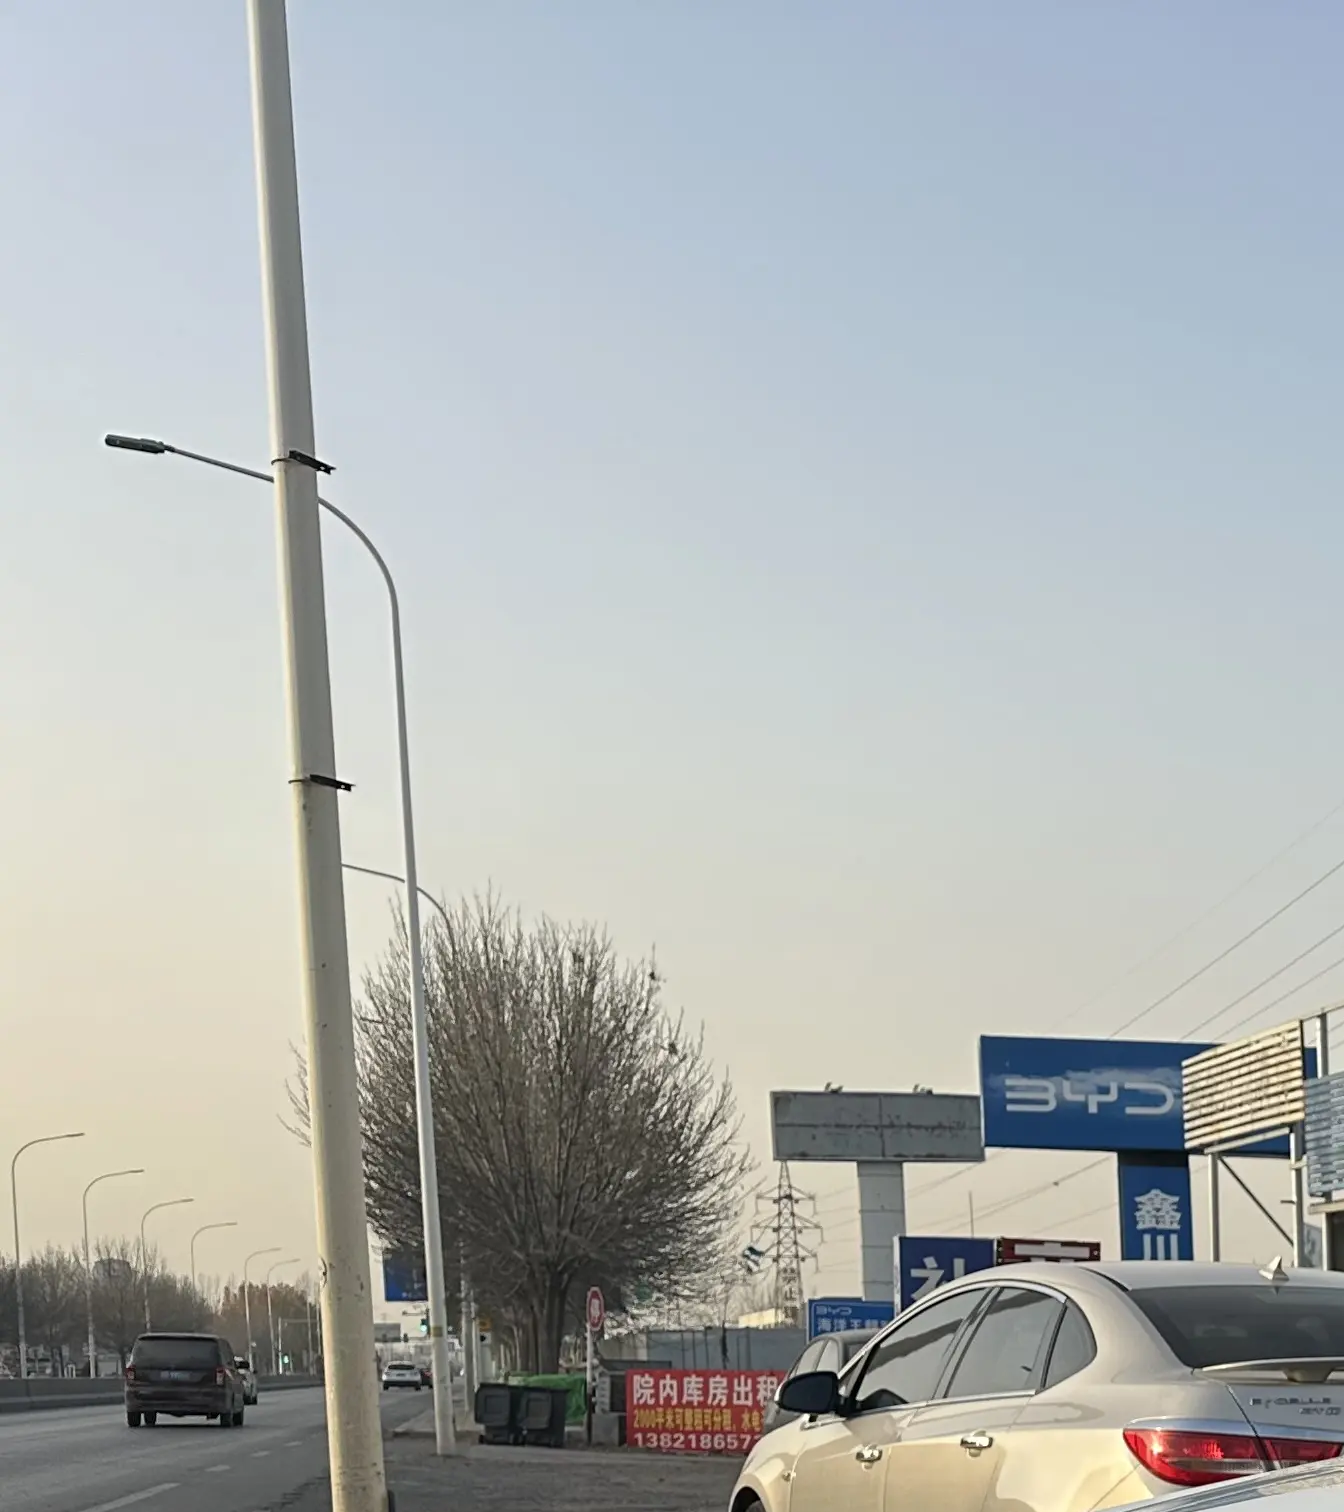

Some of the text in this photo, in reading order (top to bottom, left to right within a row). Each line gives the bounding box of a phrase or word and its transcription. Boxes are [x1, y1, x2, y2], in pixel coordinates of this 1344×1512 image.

[1004, 1077, 1175, 1115] BYD
[815, 1305, 852, 1316] BYD
[632, 1373, 778, 1407] 院内库房出租
[634, 1432, 763, 1450] 138218657
